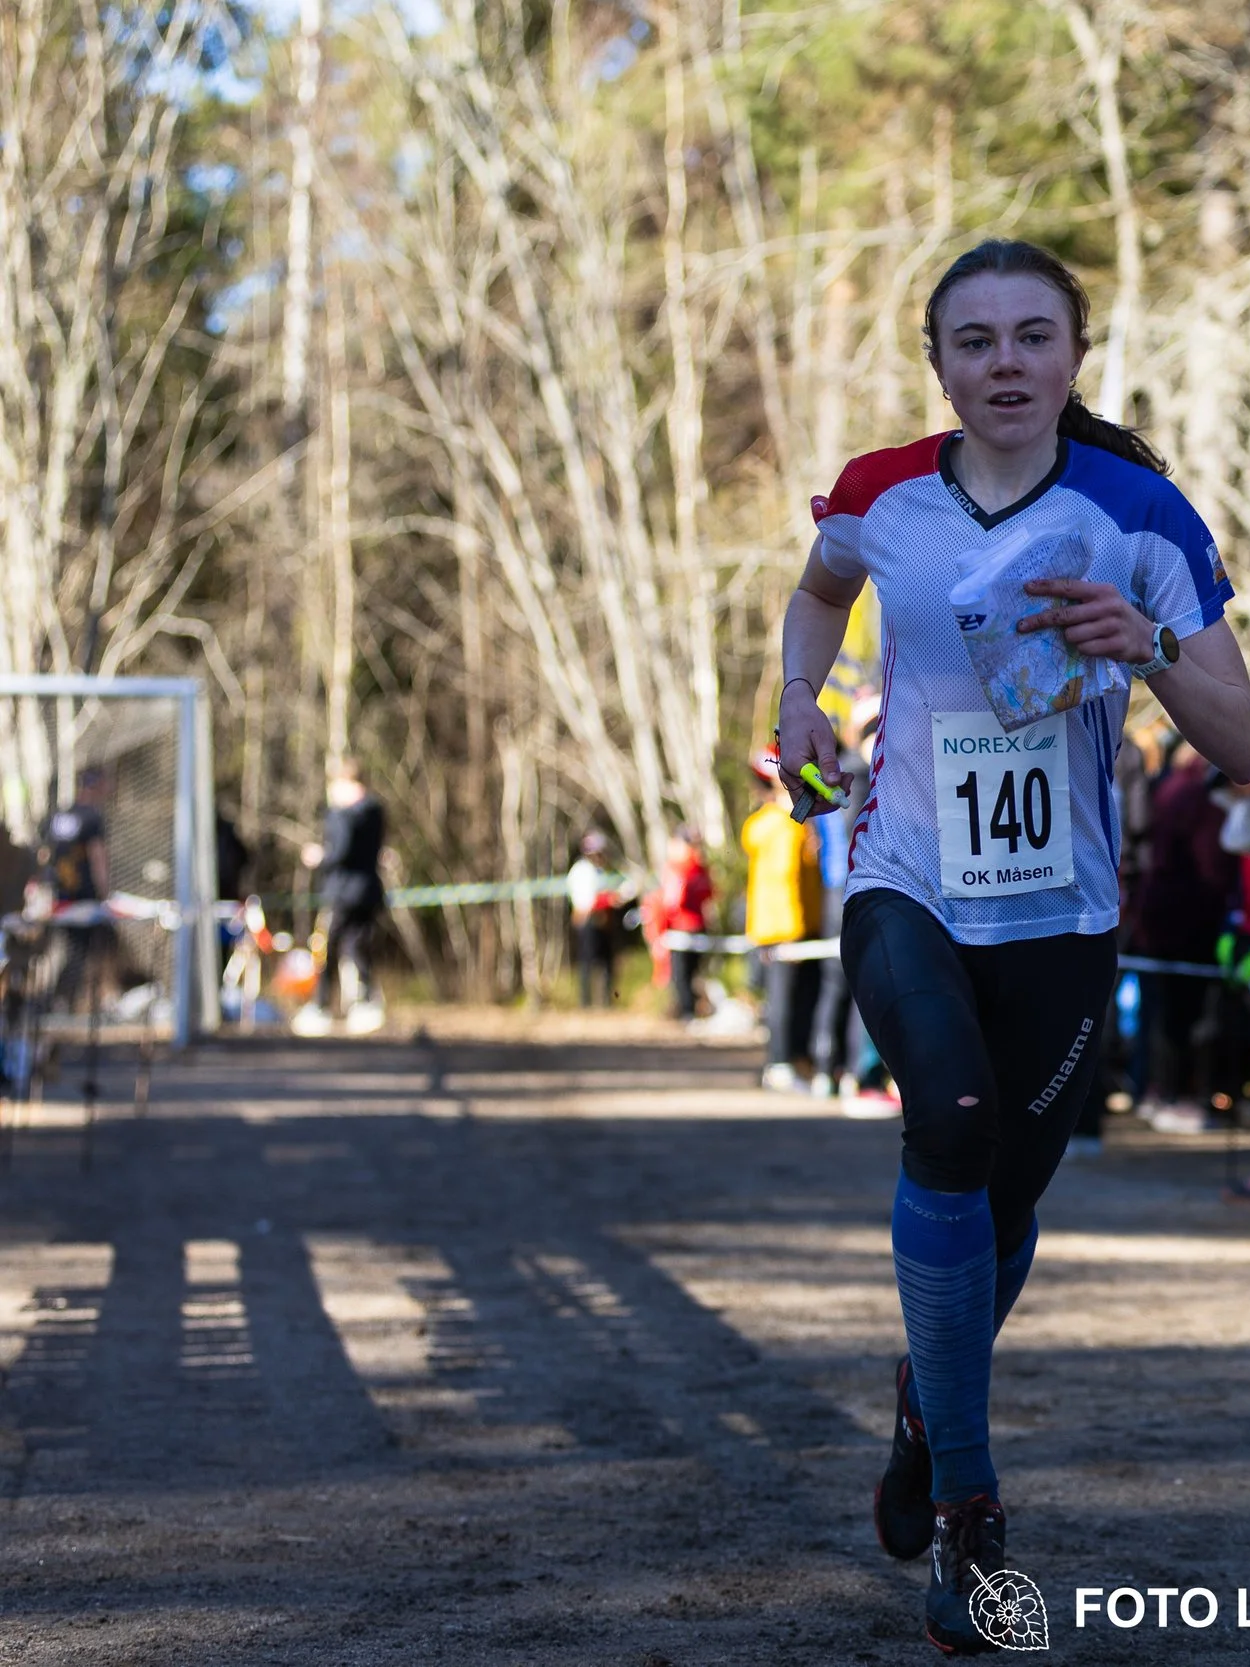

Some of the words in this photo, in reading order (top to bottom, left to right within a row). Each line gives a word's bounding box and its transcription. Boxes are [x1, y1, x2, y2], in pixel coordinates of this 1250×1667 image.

[943, 736, 1021, 754] NOREX
[956, 767, 1052, 856] 140
[962, 870, 991, 886] OK
[996, 865, 1053, 884] Måsen
[1028, 1017, 1094, 1115] noname
